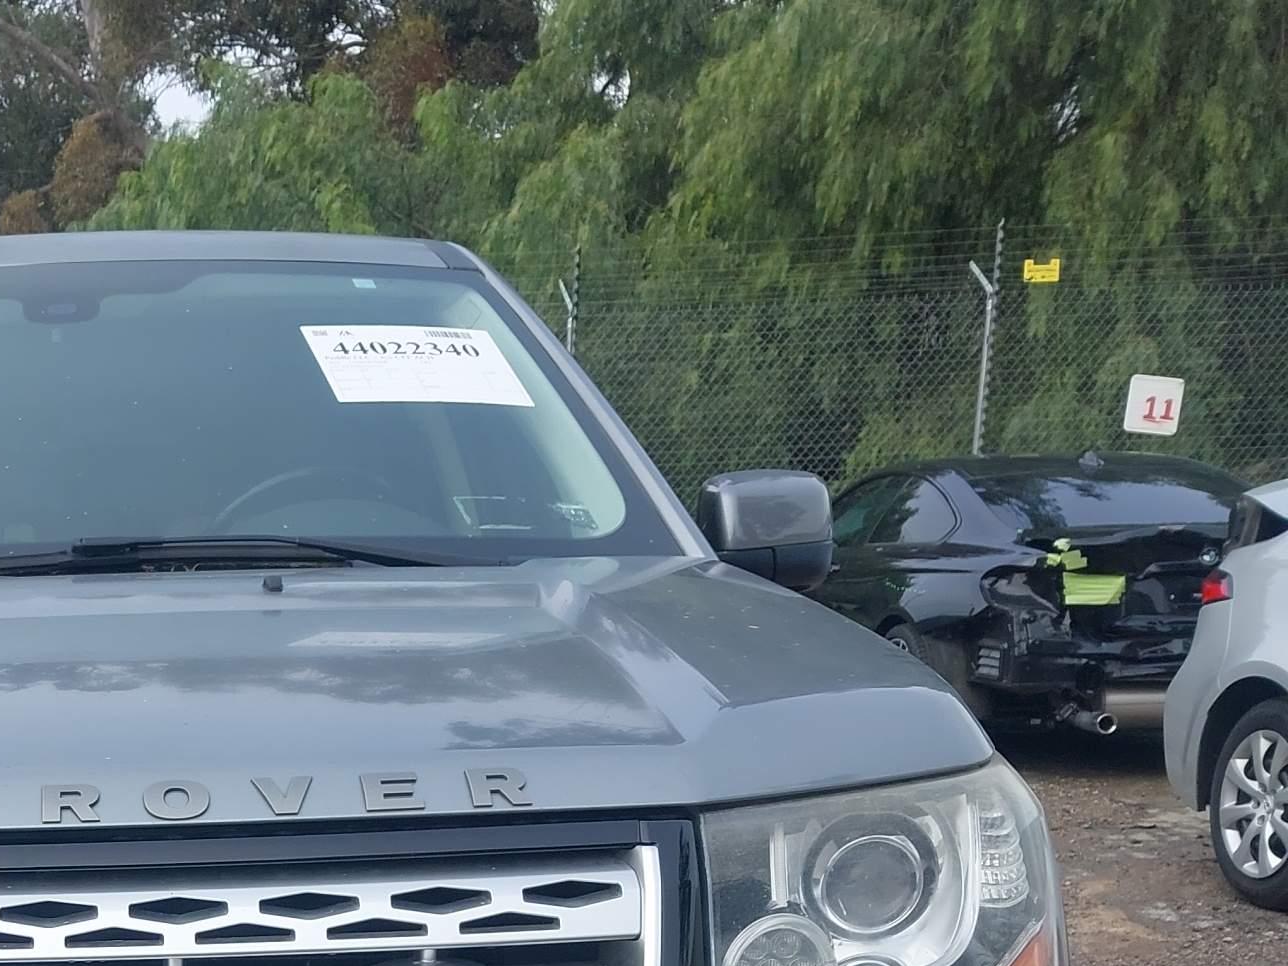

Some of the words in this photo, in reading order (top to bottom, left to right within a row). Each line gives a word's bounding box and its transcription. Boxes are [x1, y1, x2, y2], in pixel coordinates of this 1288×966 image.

[332, 340, 481, 358] 44022340
[1143, 396, 1174, 420] 11
[40, 766, 534, 824] ROVER
